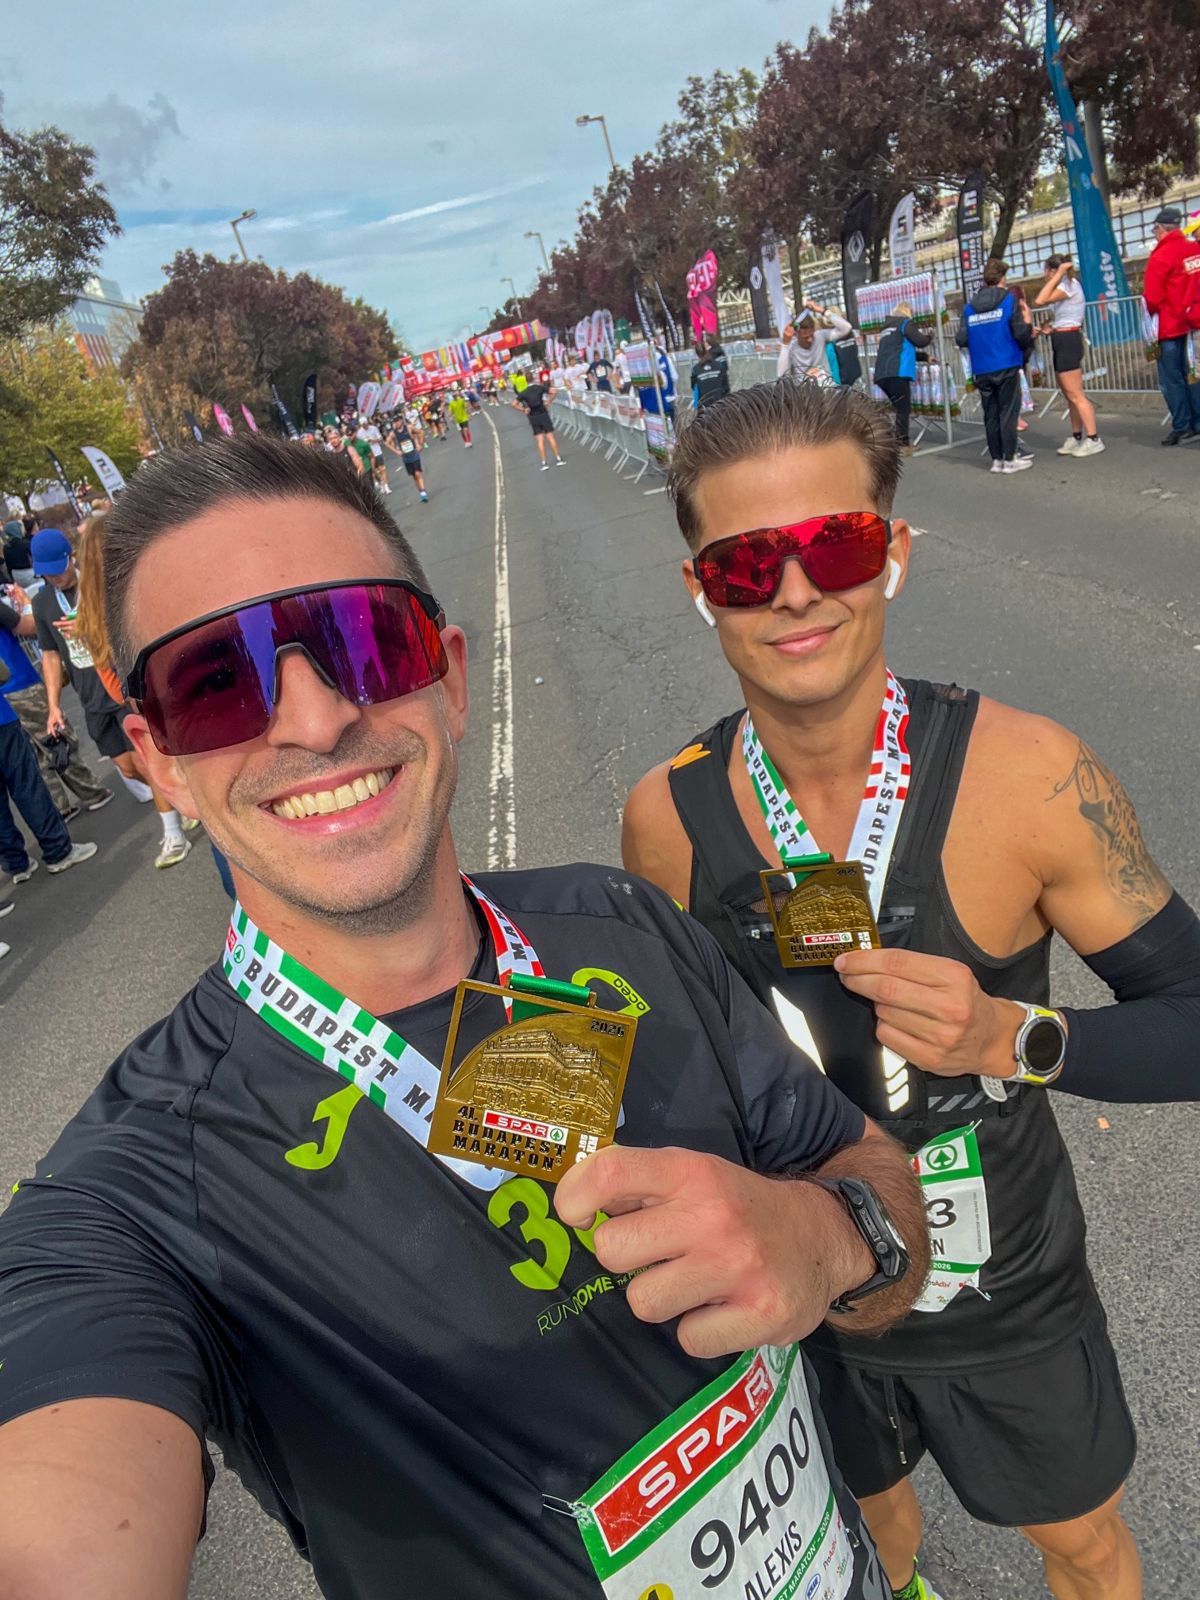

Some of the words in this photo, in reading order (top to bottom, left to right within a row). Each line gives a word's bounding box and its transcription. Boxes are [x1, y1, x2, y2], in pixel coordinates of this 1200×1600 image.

[747, 745, 799, 846] BUDAPEST
[863, 771, 899, 876] UDAPEST
[887, 683, 903, 761] MARAT
[244, 958, 398, 1083] BUDAPEST
[452, 1119, 566, 1159] BUDAPEST
[497, 1117, 547, 1138] SPAR
[638, 1367, 770, 1509] SPAR
[690, 1407, 810, 1589] 9400
[744, 1520, 803, 1600] ALEXIS
